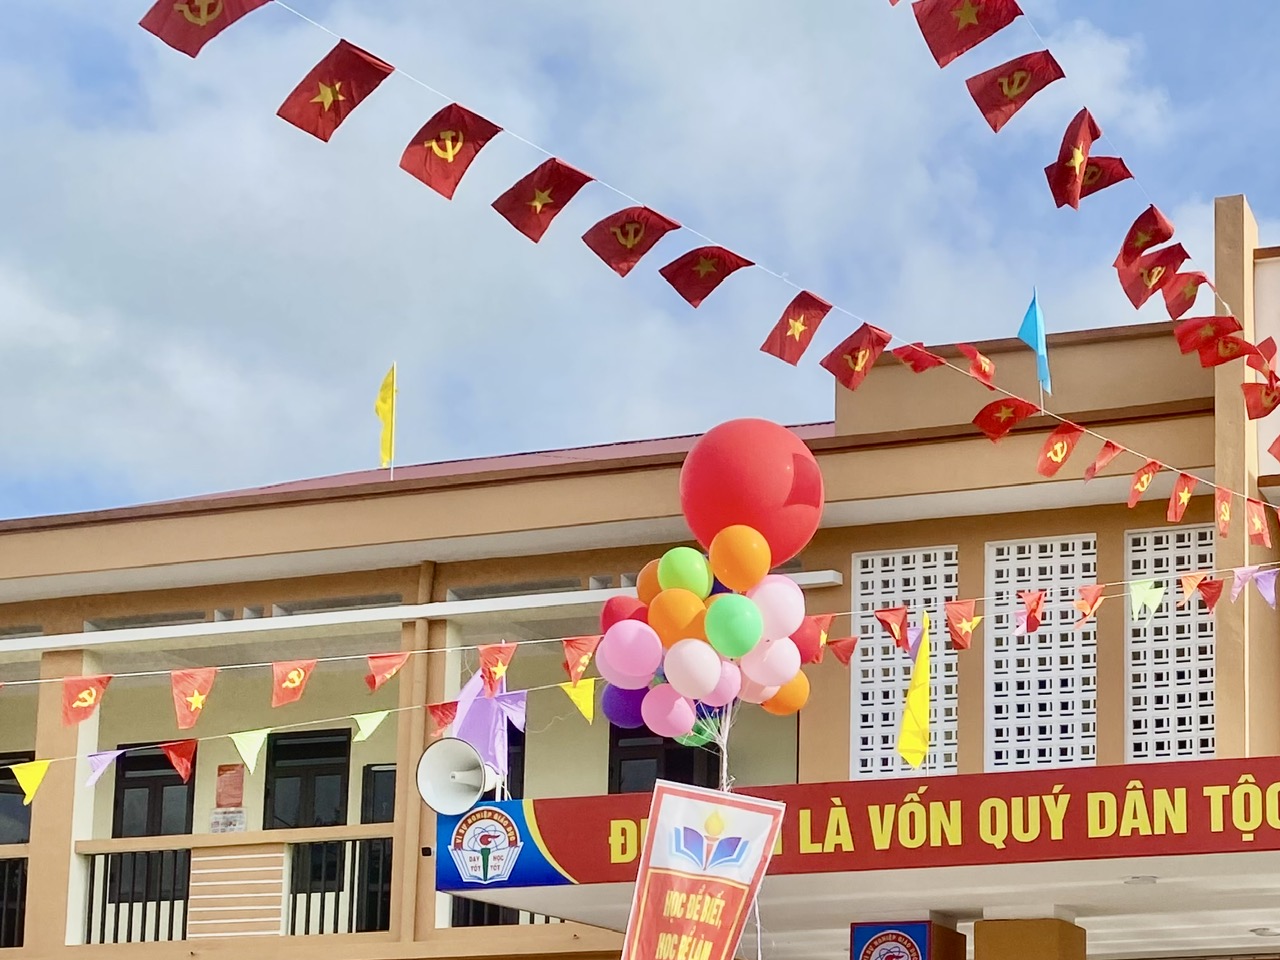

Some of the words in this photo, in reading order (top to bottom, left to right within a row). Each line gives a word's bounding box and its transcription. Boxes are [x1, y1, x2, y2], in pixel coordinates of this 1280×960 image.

[799, 798, 855, 855] LÀ
[868, 785, 962, 851] VỐN
[979, 784, 1072, 849] QUÝ
[1088, 780, 1188, 839] DÂN
[663, 890, 687, 923] HỌC
[685, 884, 706, 921] ĐỂ
